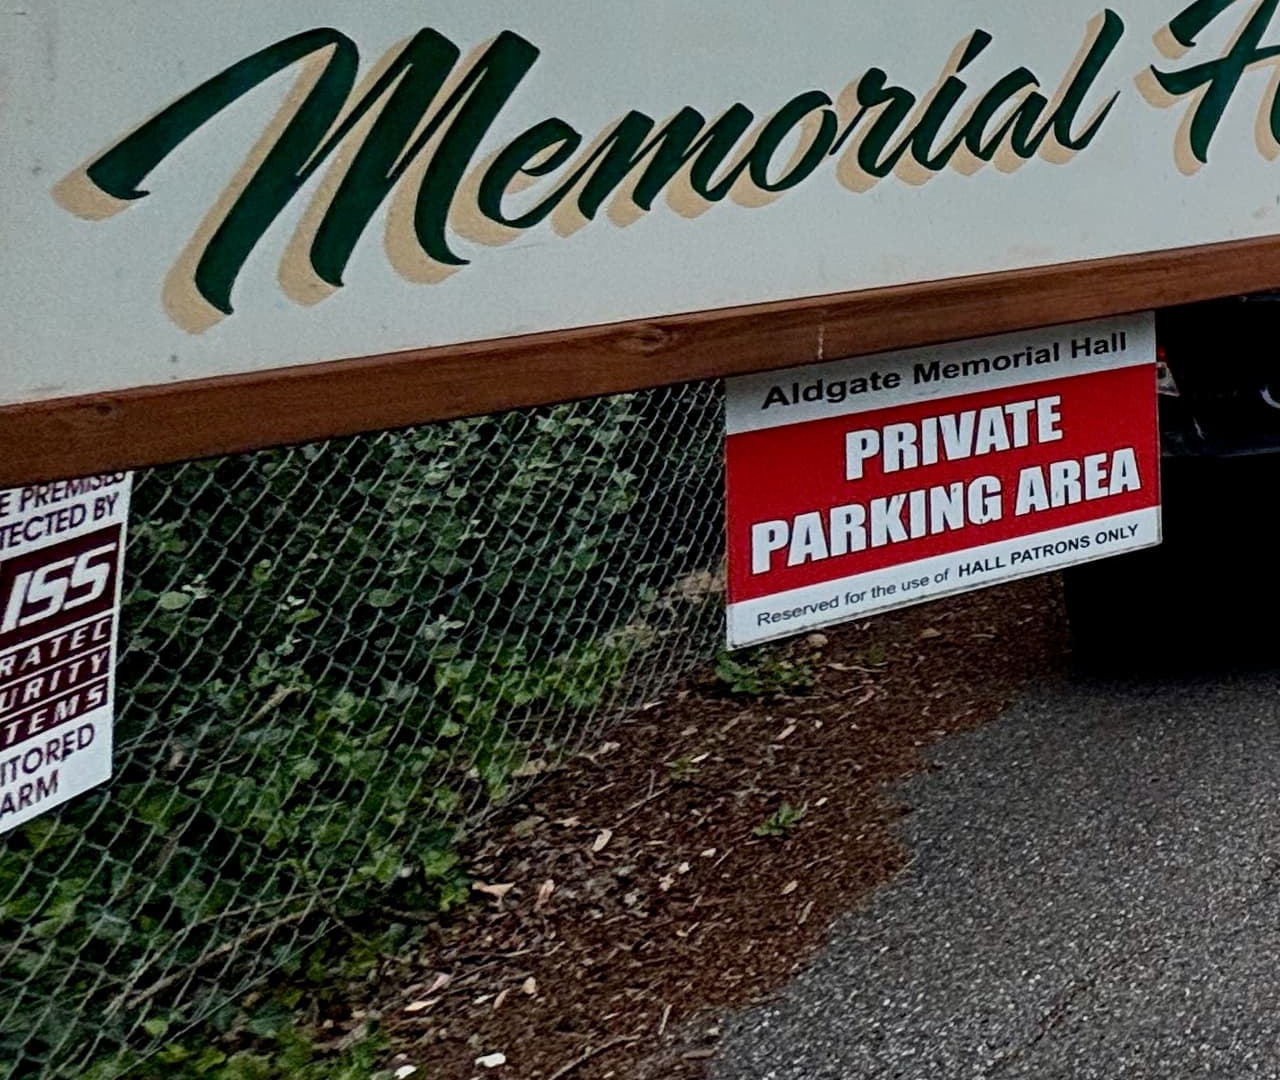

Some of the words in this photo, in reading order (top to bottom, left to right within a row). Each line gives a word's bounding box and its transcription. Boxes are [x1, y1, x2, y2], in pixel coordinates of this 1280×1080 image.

[66, 6, 1124, 324] Memorial
[761, 371, 902, 410] Aldgate
[913, 342, 1061, 384] Memorial
[1071, 331, 1127, 359] Hall
[844, 394, 1065, 482] PRIVATE
[93, 491, 120, 521] BY
[749, 474, 1004, 576] PARKING
[1014, 447, 1143, 517] AREA
[757, 594, 841, 627] Reserved
[844, 588, 868, 606] for
[871, 579, 897, 598] the
[901, 575, 931, 593] use
[934, 568, 950, 585] of
[957, 554, 1006, 579] HALL
[1010, 533, 1091, 566] PATRONS
[1095, 522, 1140, 545] ONLY
